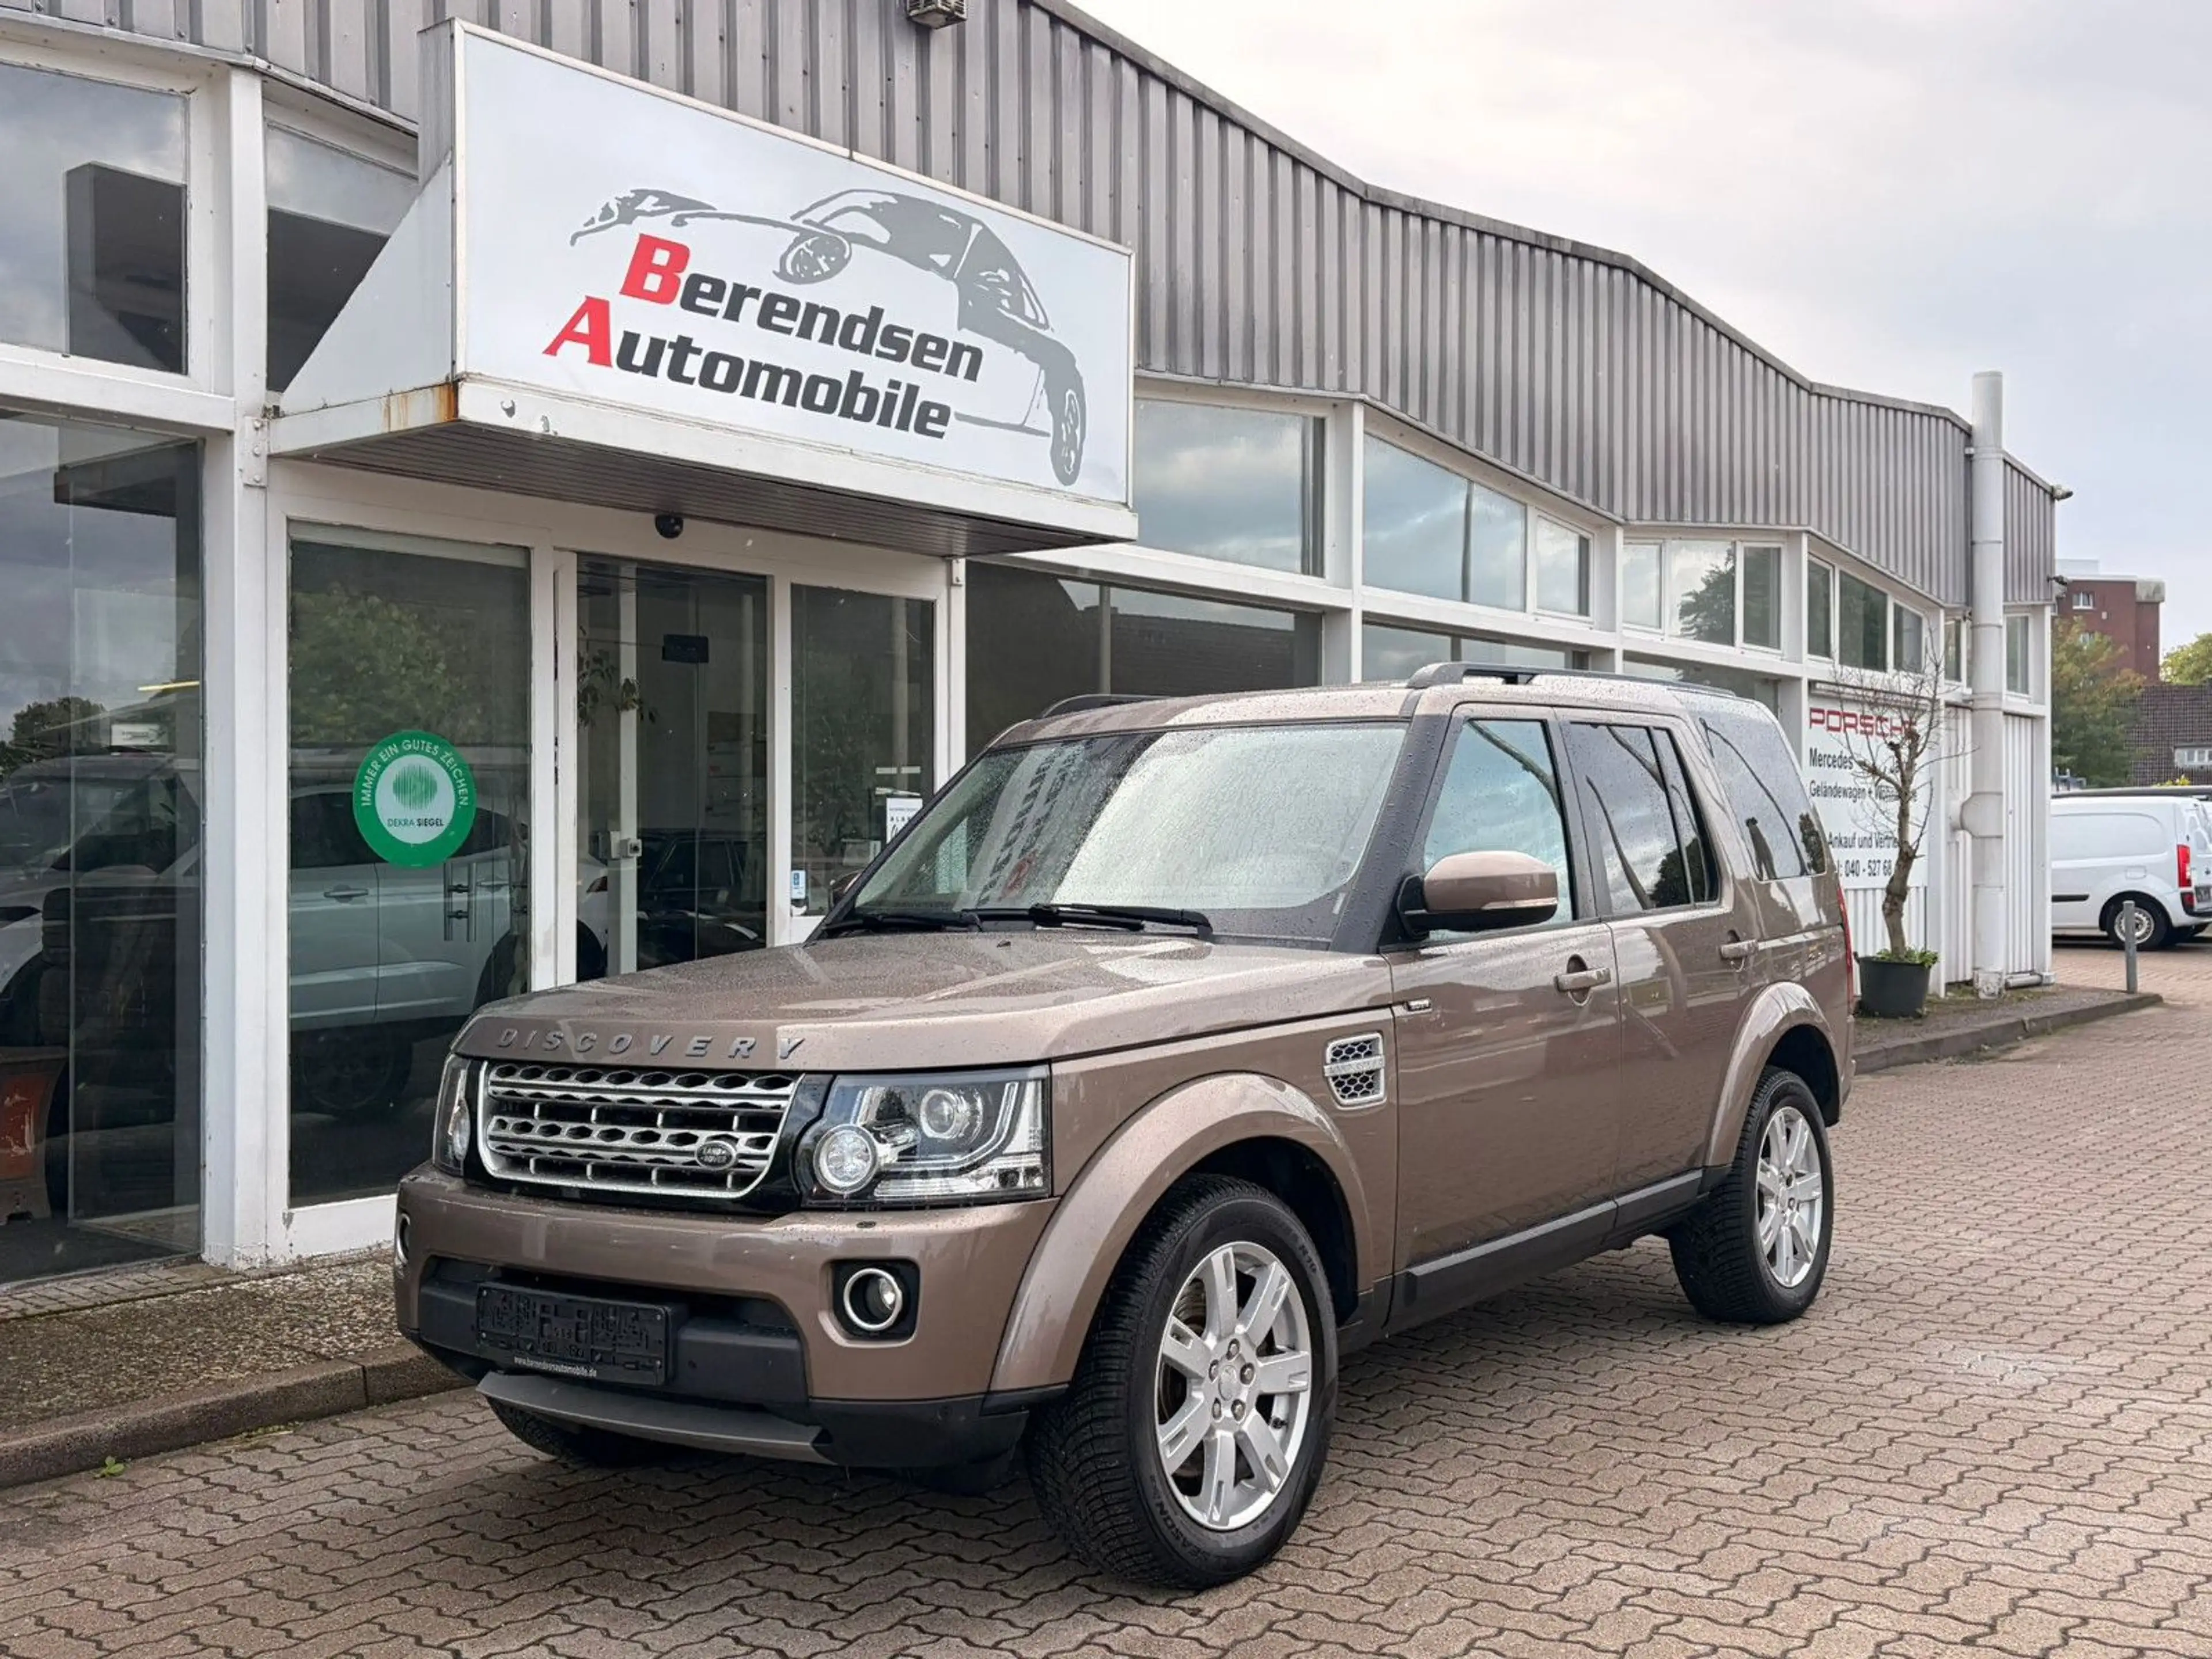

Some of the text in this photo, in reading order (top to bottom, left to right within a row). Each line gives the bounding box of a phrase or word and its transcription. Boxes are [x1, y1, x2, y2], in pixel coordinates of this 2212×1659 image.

[619, 233, 984, 382] Berendsen
[542, 295, 952, 439] Automobile
[361, 739, 468, 806] IMMER EIN GUTES ZEICHEN
[1809, 748, 1853, 770] Mercedes
[1810, 779, 1866, 802] Geländewagen
[387, 818, 446, 827] DEKRA SIEGEL
[1844, 859, 1860, 877] 040
[1868, 859, 1881, 877] 527
[497, 1028, 805, 1060] DISCOVERY
